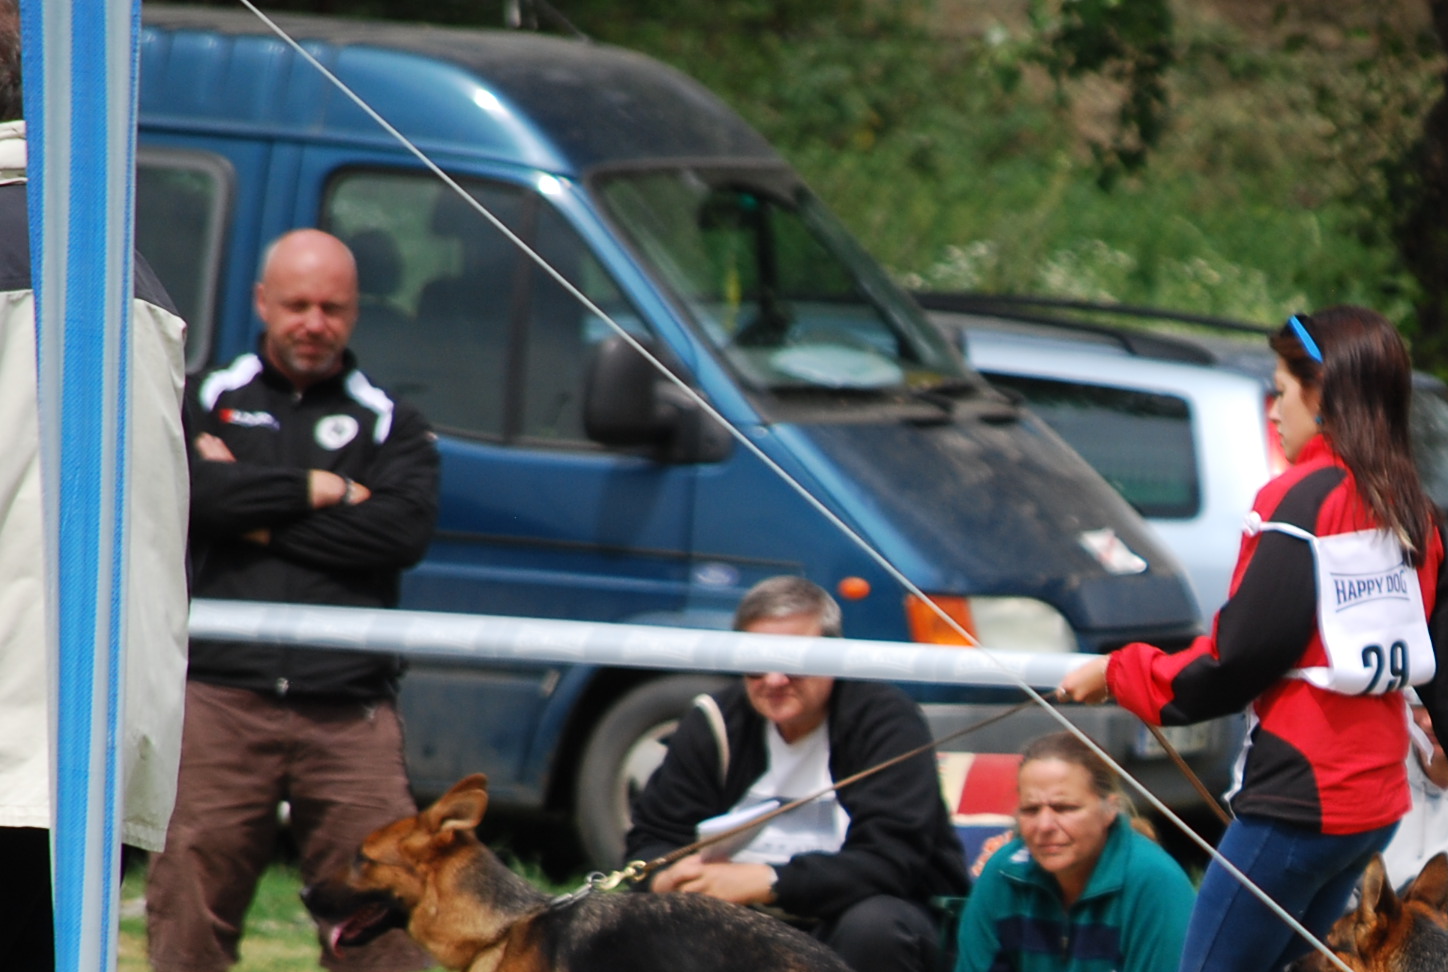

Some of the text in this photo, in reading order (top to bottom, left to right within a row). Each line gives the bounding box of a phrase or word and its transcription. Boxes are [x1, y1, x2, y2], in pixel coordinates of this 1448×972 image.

[1333, 569, 1408, 606] HAPPY DOG
[1361, 638, 1410, 695] 29
